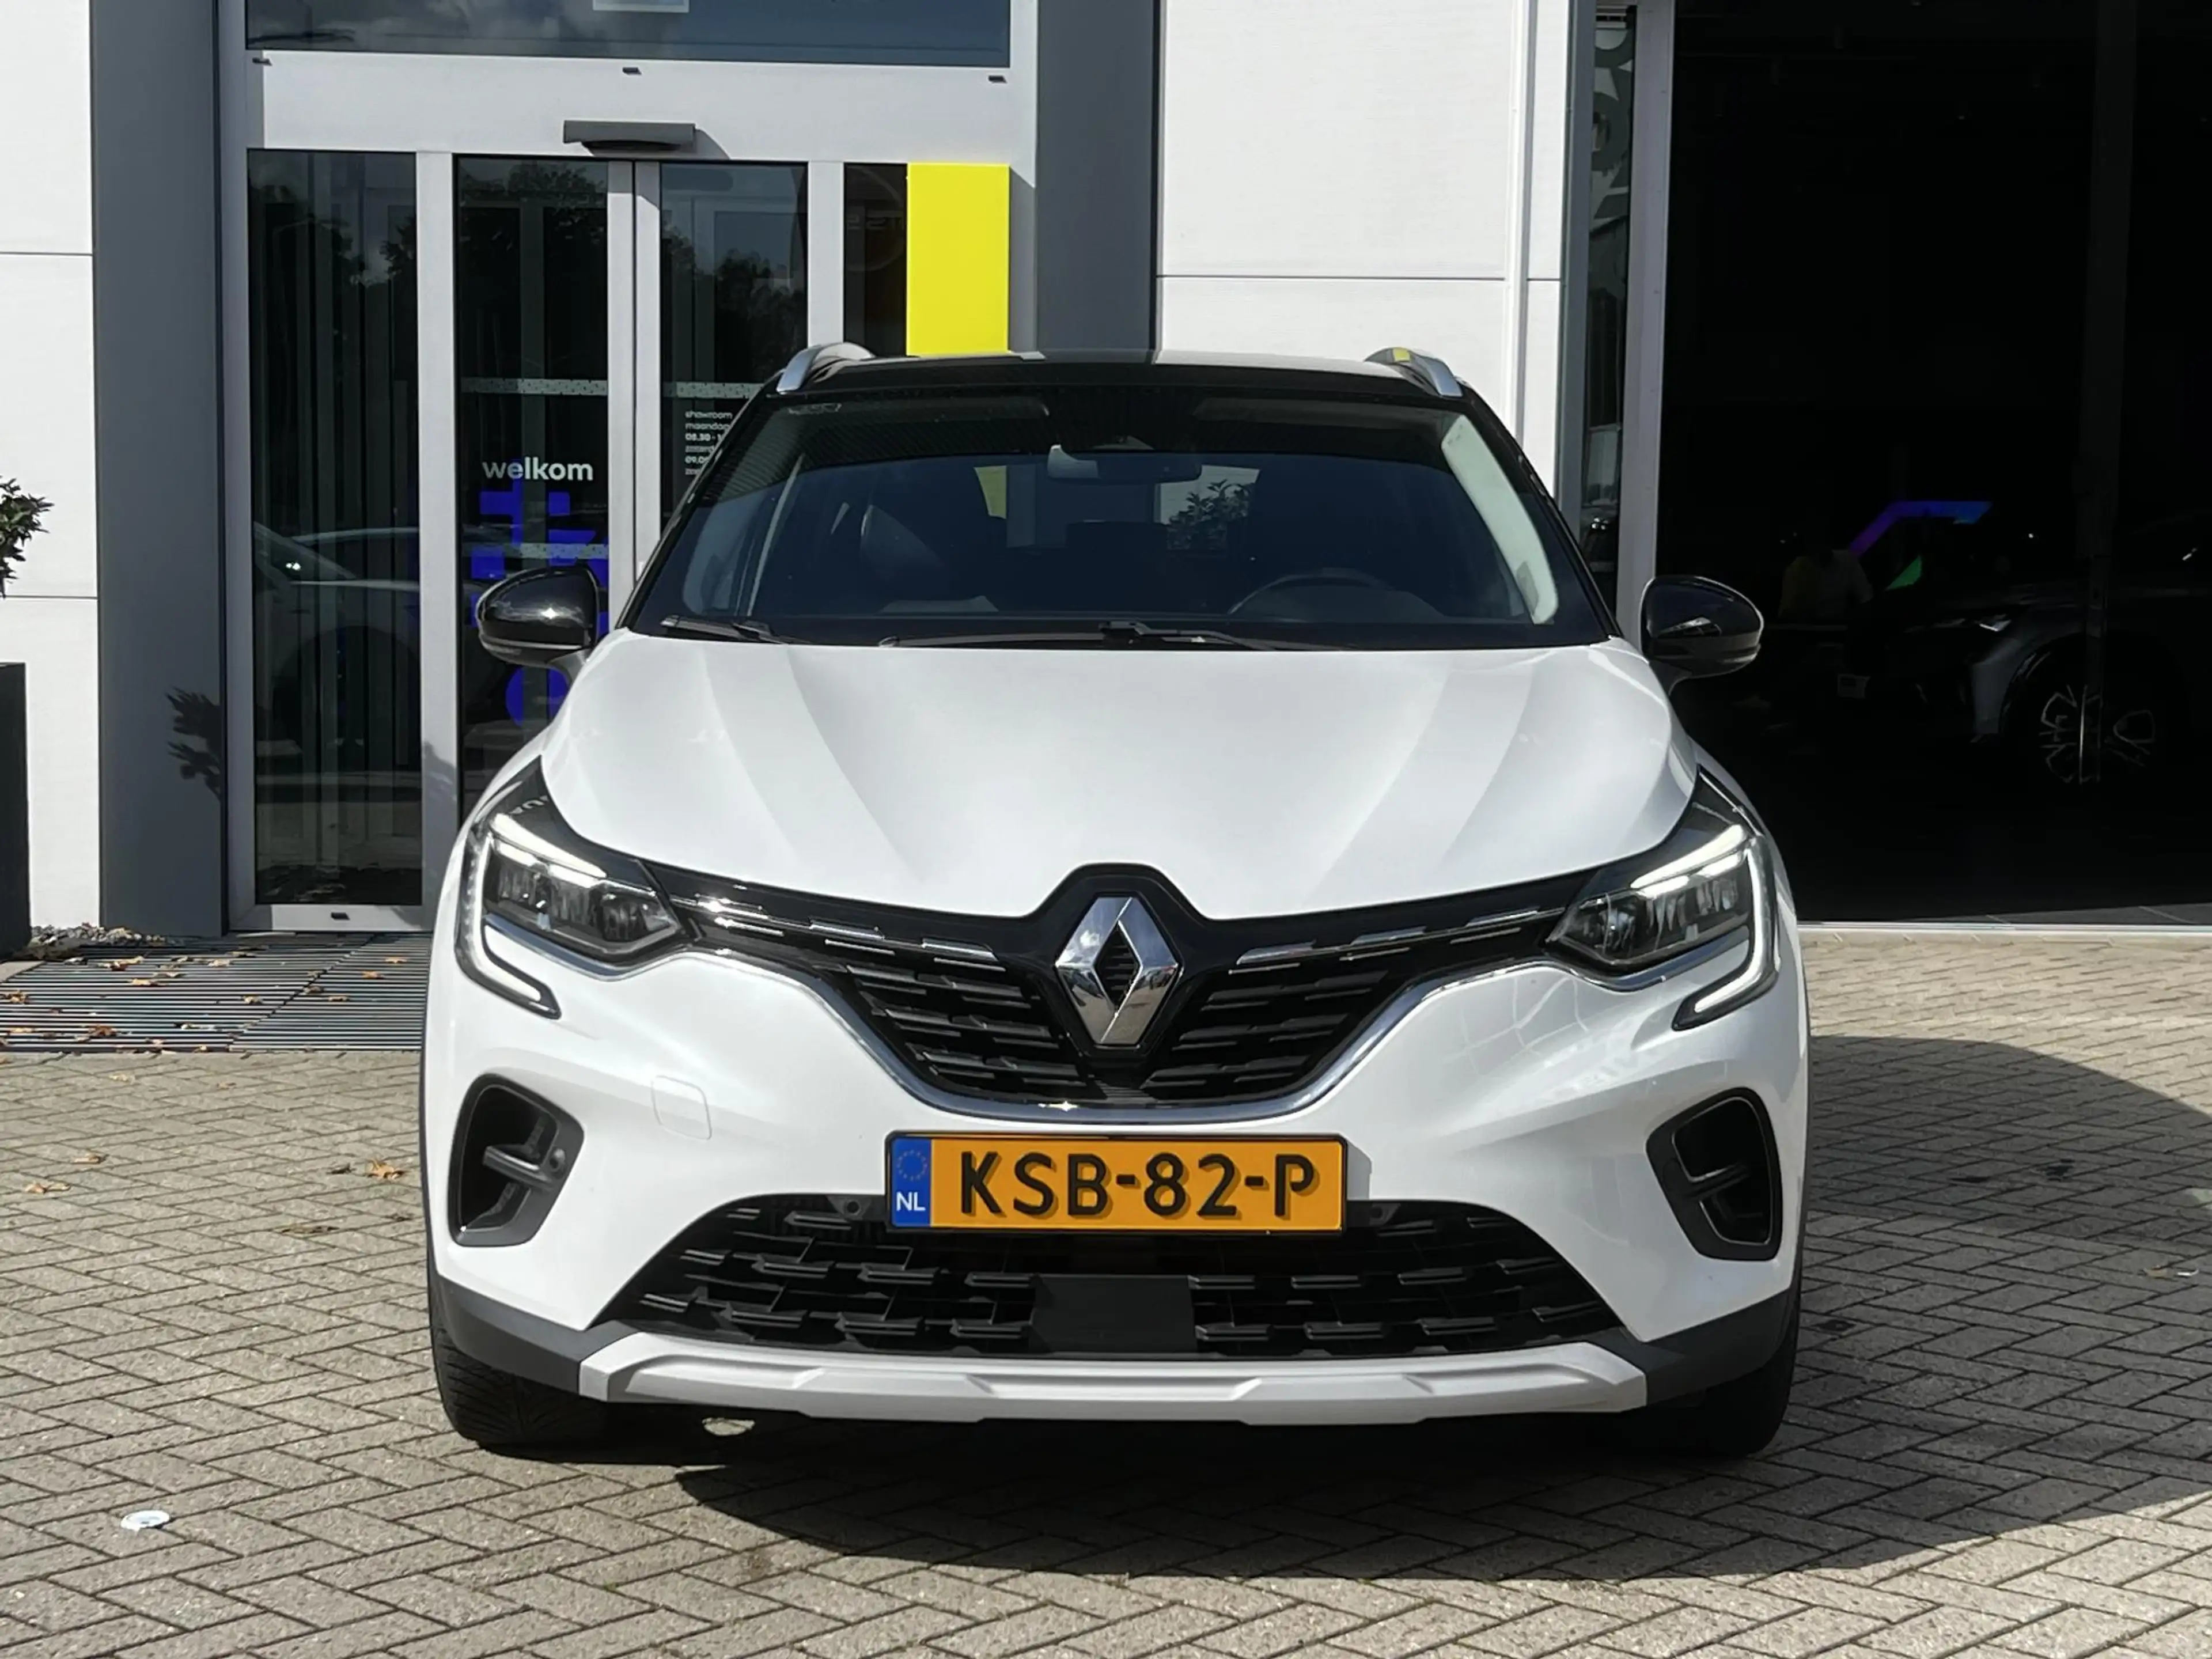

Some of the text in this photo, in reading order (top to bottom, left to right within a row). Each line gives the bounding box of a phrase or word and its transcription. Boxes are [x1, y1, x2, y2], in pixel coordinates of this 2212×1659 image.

[685, 411, 733, 419] showroom
[482, 456, 593, 481] welkom
[960, 1150, 1315, 1218] KSB-82-P
[896, 1191, 926, 1211] NL
